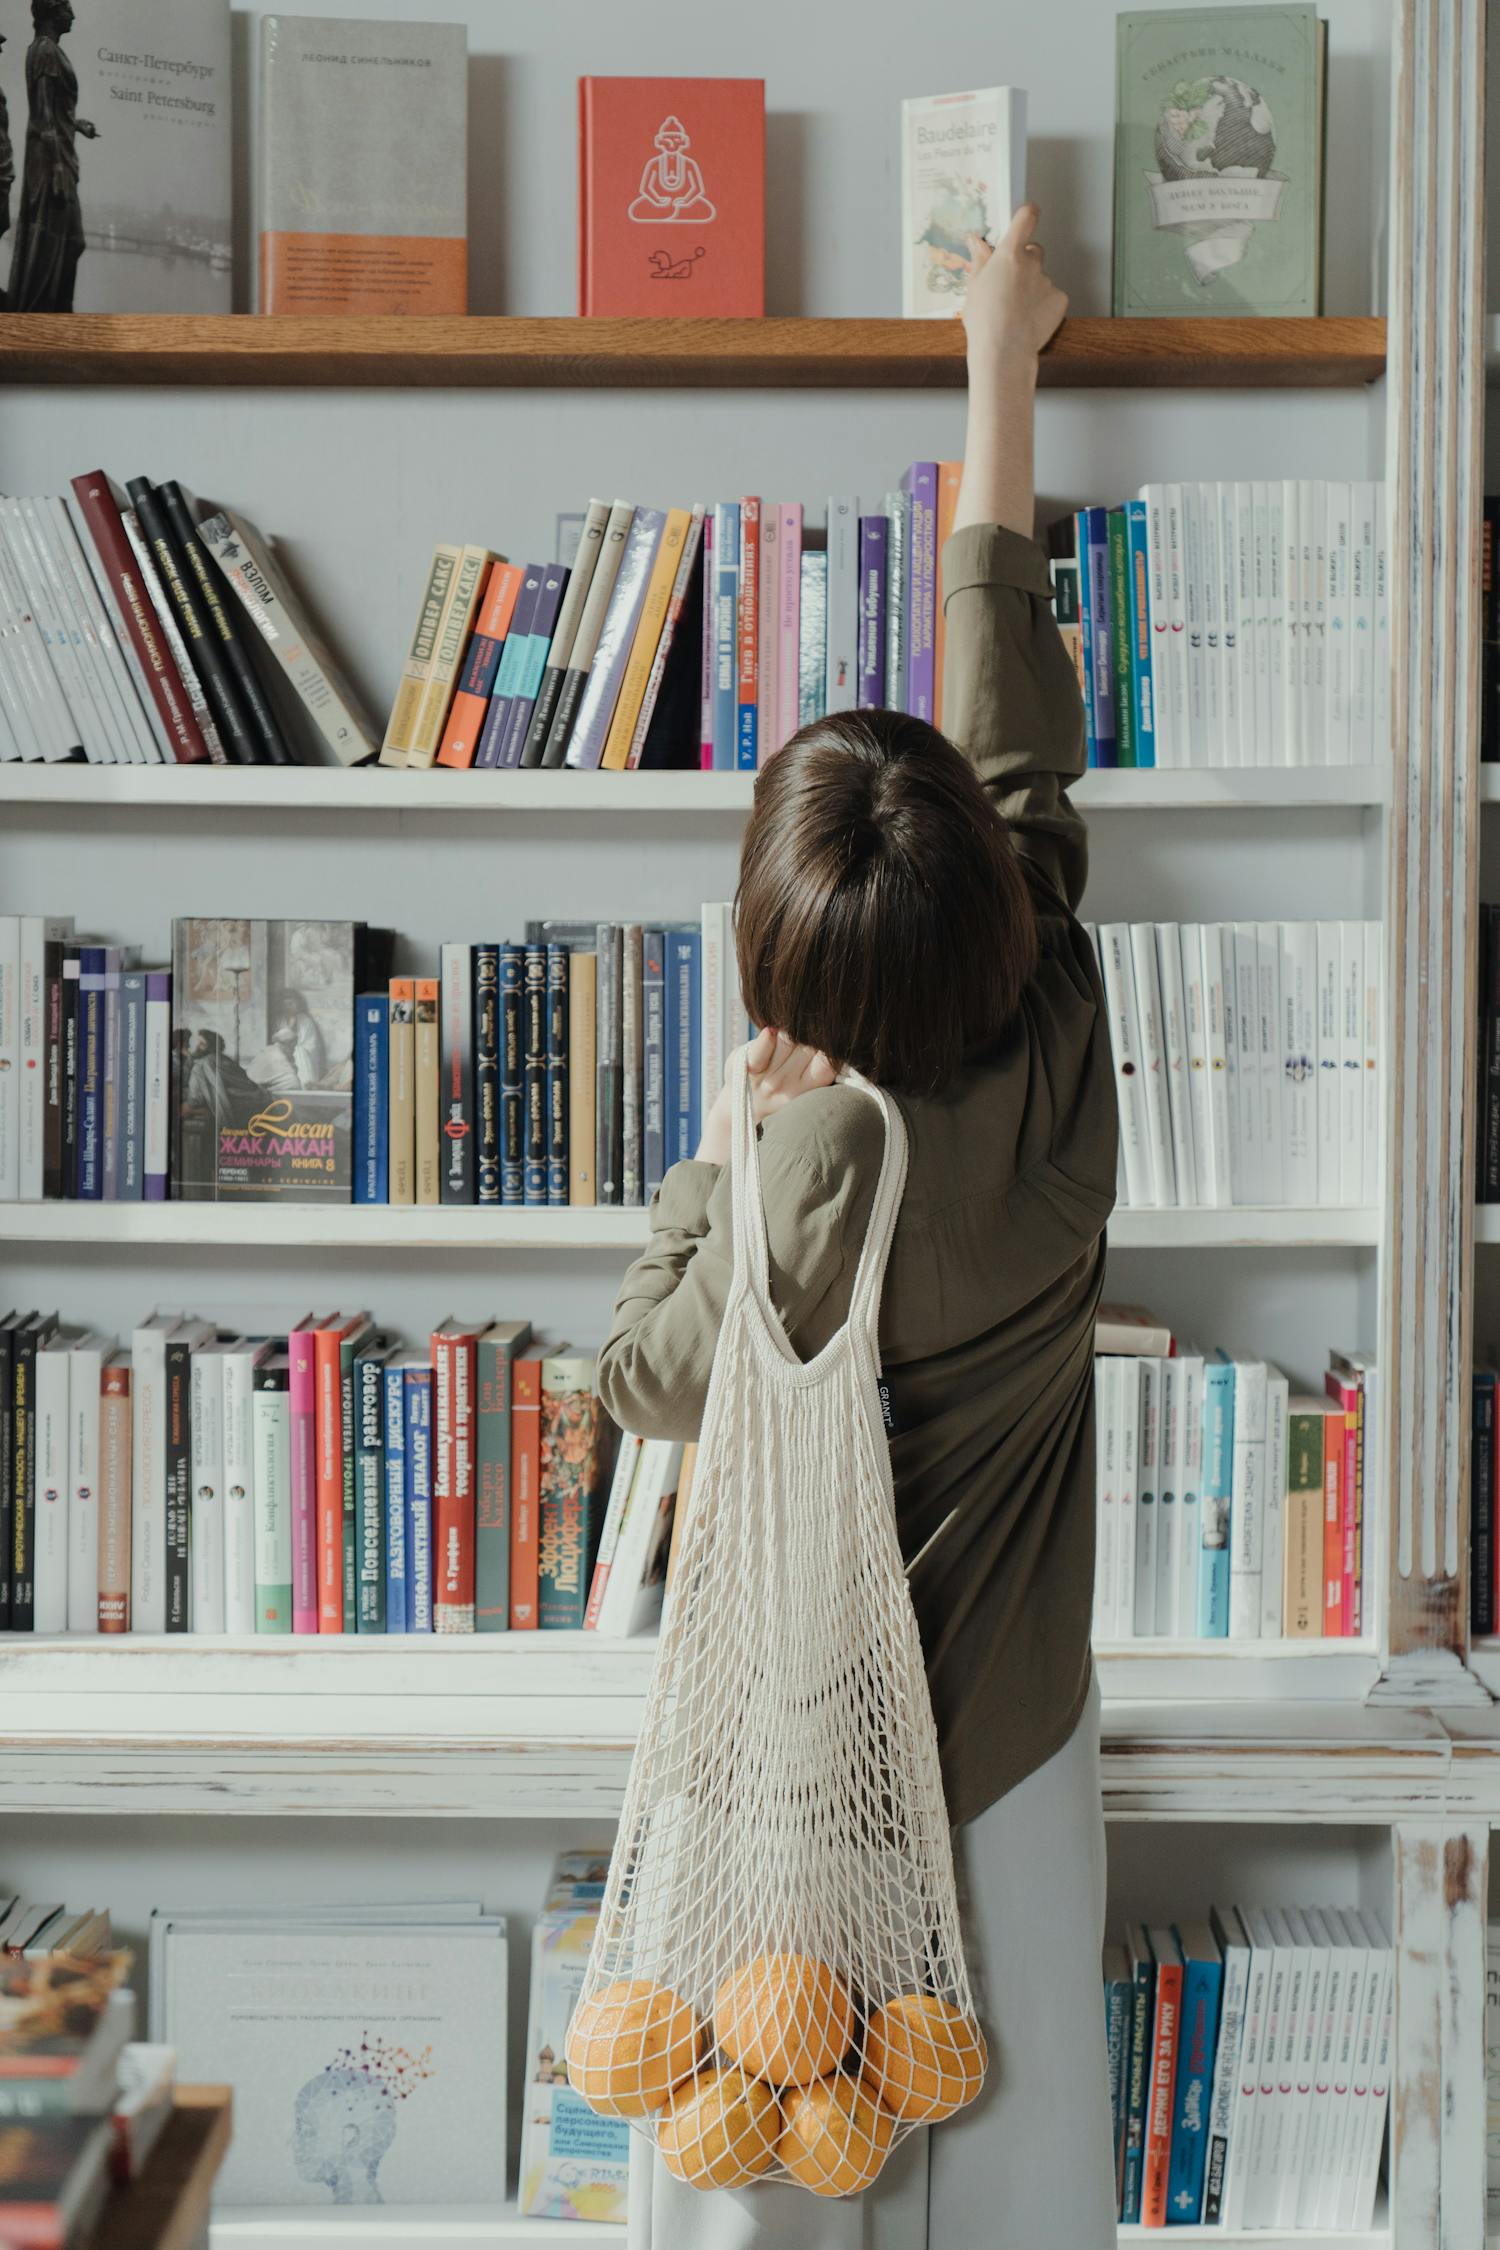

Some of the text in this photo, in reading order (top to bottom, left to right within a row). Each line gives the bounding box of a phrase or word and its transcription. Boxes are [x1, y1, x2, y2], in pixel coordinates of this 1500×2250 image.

[97, 48, 216, 80] Санкт-Петербург
[109, 86, 216, 117] Saint Petersburg
[917, 120, 998, 146] Baudelaire
[413, 599, 444, 658] ОЛИВЕР
[430, 558, 455, 597] САКС
[437, 560, 479, 660] ОЛИВЕР САКС
[743, 542, 756, 632] отношениях
[742, 650, 756, 684] Гнев
[1117, 628, 1130, 675] Сундучок
[126, 1102, 136, 1136] СЛОВАРЬ
[248, 1099, 335, 1138] Lacan
[366, 1032, 378, 1199] КРАТКИЙ ПСИХОЛОГИЧЕСКИЙ СЛОВАРЬ
[482, 1082, 494, 1144] Эрих ФРОММ
[530, 1082, 542, 1144] Эрих ФРОММ
[552, 1080, 563, 1144] Эрих ФРОММ
[82, 1162, 95, 1191] Натан
[219, 1137, 335, 1157] ЖАК ЛАКАН
[219, 1156, 336, 1172] СЕМИНАРЫ КНИГА 8
[15, 1362, 26, 1406] ВРЕМЕНИ
[172, 1374, 181, 1404] СТРЕССА
[478, 1381, 492, 1414] Сон
[491, 1346, 506, 1412] Бодлера
[879, 1386, 892, 1424] GRANIT
[15, 1407, 26, 1446] НАШЕГО
[343, 1376, 352, 1452] УКРОТИТЕЛЬ
[435, 1344, 453, 1498] Коммуникация:
[456, 1346, 472, 1497] теории и практики
[15, 1448, 26, 1496] ЛИЧНОСТЬ
[108, 1406, 118, 1584] ТЕРАПИЯ ЭМОЦИОНАЛЬНЫХ СХЕМ
[141, 1384, 154, 1603] Роберт Сапольски ПСИХОЛОГИЯ СТРЕССА
[264, 1432, 280, 1533] Конфликтология
[344, 1456, 354, 1511] ТРОЛЛЕЙ
[359, 1362, 382, 1582] Повседневный разговор
[386, 1375, 405, 1580] РАЗГОВОРНЫЙ ДИСКУРС
[478, 1461, 494, 1528] Роберто
[491, 1462, 505, 1528] Калассо
[15, 1498, 26, 1574] НЕВРОТИЧЕСКАЯ
[409, 1429, 430, 1630] КОНФЛИКТНЫЙ ДИАЛОГ
[446, 1526, 460, 1592] Э. Гриффин
[538, 1502, 559, 1578] Эффект
[1109, 1996, 1122, 2095] МИЛОСЕРДИЯ
[1131, 1992, 1146, 2108] КРАСНЫЕ БРАСЛЕТЫ
[1154, 2001, 1174, 2137] ДЕРЖИ ЕГО ЗА РУКУ
[1222, 2010, 1238, 2079] МЕНТАЛИЗМА
[1214, 2082, 1232, 2130] ФЕНОМЕН
